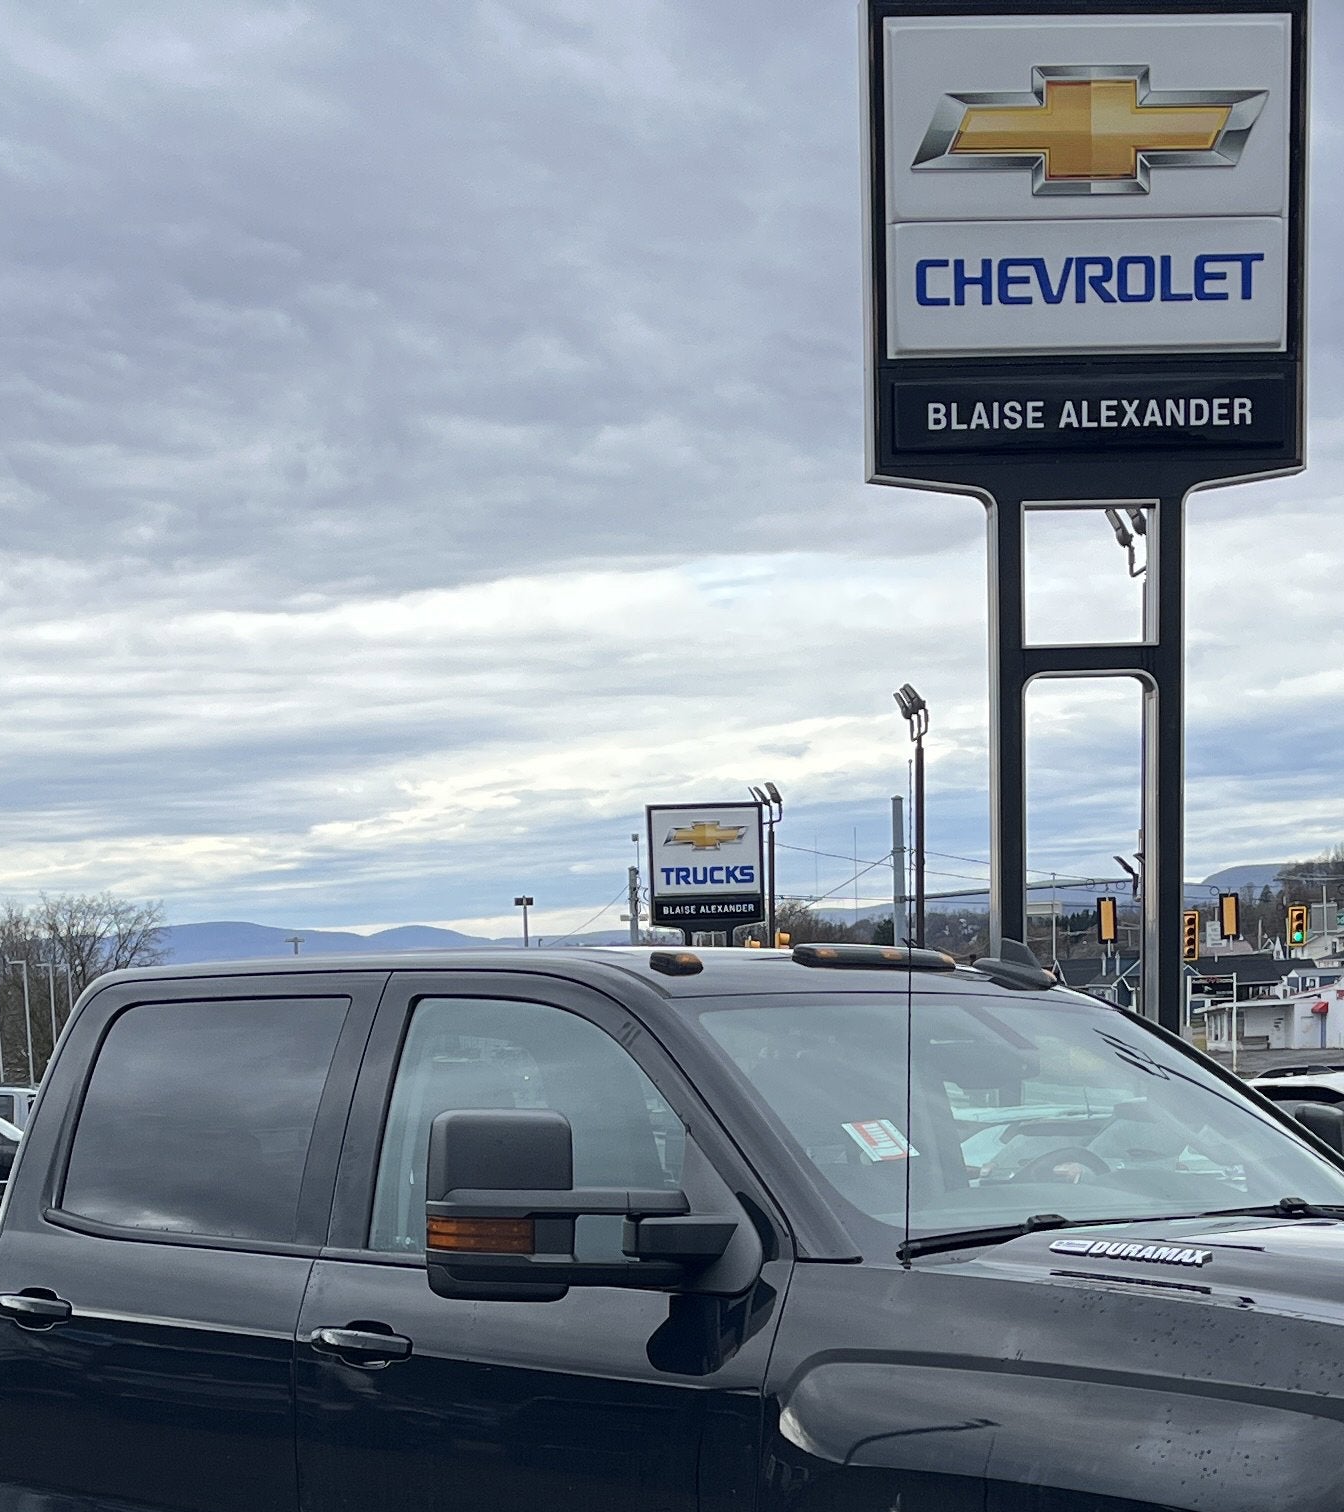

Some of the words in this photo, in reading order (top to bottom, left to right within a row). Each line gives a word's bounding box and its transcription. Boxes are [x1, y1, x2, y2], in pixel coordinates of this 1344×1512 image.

[916, 253, 1265, 306] CHEVROLET
[927, 402, 1045, 431] BLAISE
[1059, 398, 1253, 428] ALEXANDER
[660, 865, 755, 885] TRUCKS
[663, 905, 696, 915] BLAISE
[699, 903, 755, 914] ALEXANDER
[1087, 1240, 1213, 1268] DURAMAX
